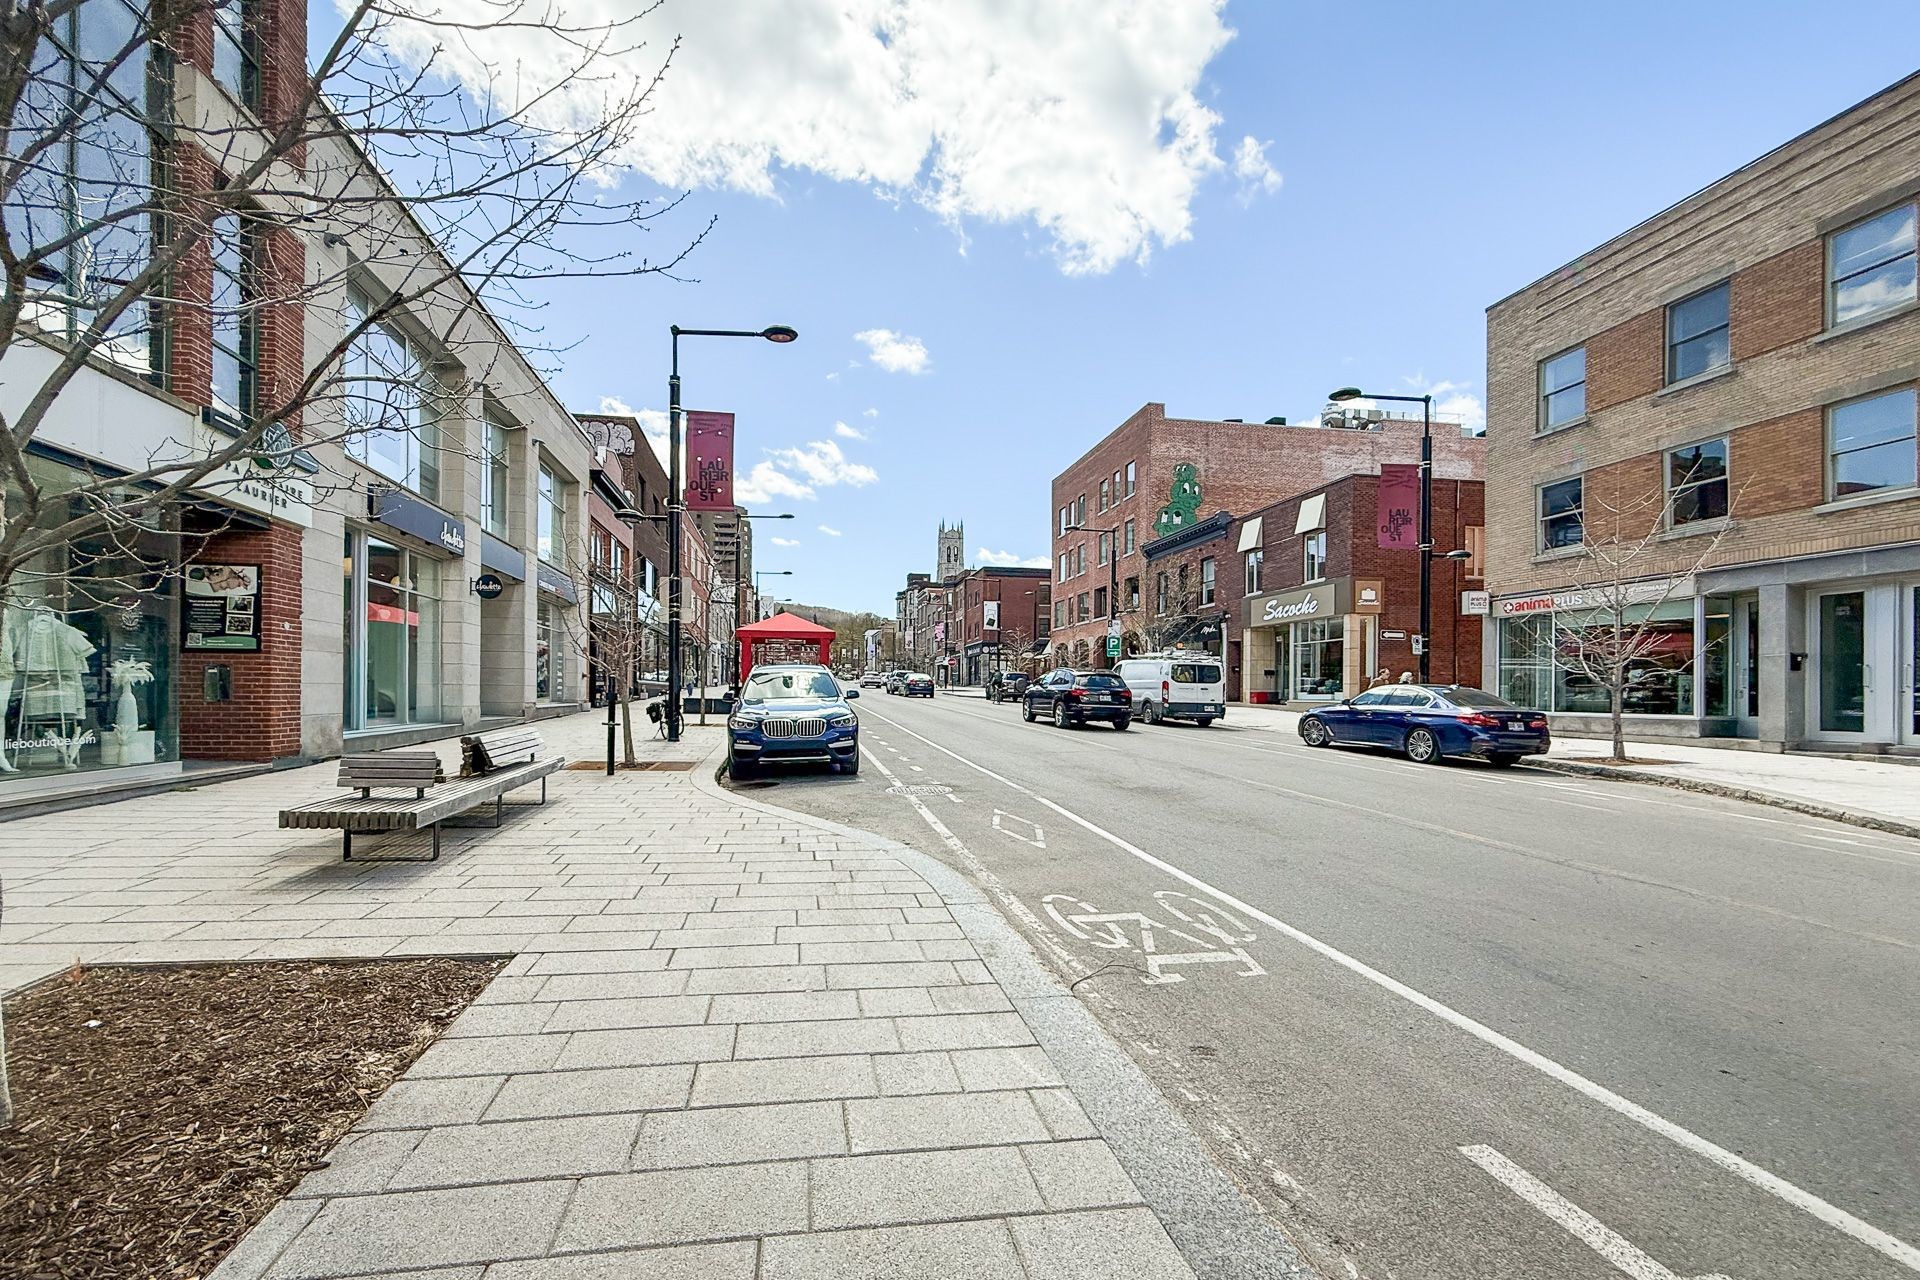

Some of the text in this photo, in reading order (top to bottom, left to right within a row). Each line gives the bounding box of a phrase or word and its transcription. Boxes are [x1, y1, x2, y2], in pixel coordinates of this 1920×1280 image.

[699, 460, 725, 471] LAU
[689, 480, 718, 491] OUE
[236, 481, 287, 509] LAURIER
[700, 490, 717, 502] ST
[1388, 508, 1410, 518] LAU
[1380, 524, 1403, 534] OUE
[1389, 533, 1403, 542] ST
[1262, 592, 1319, 621] Sacoche
[1109, 638, 1119, 649] P
